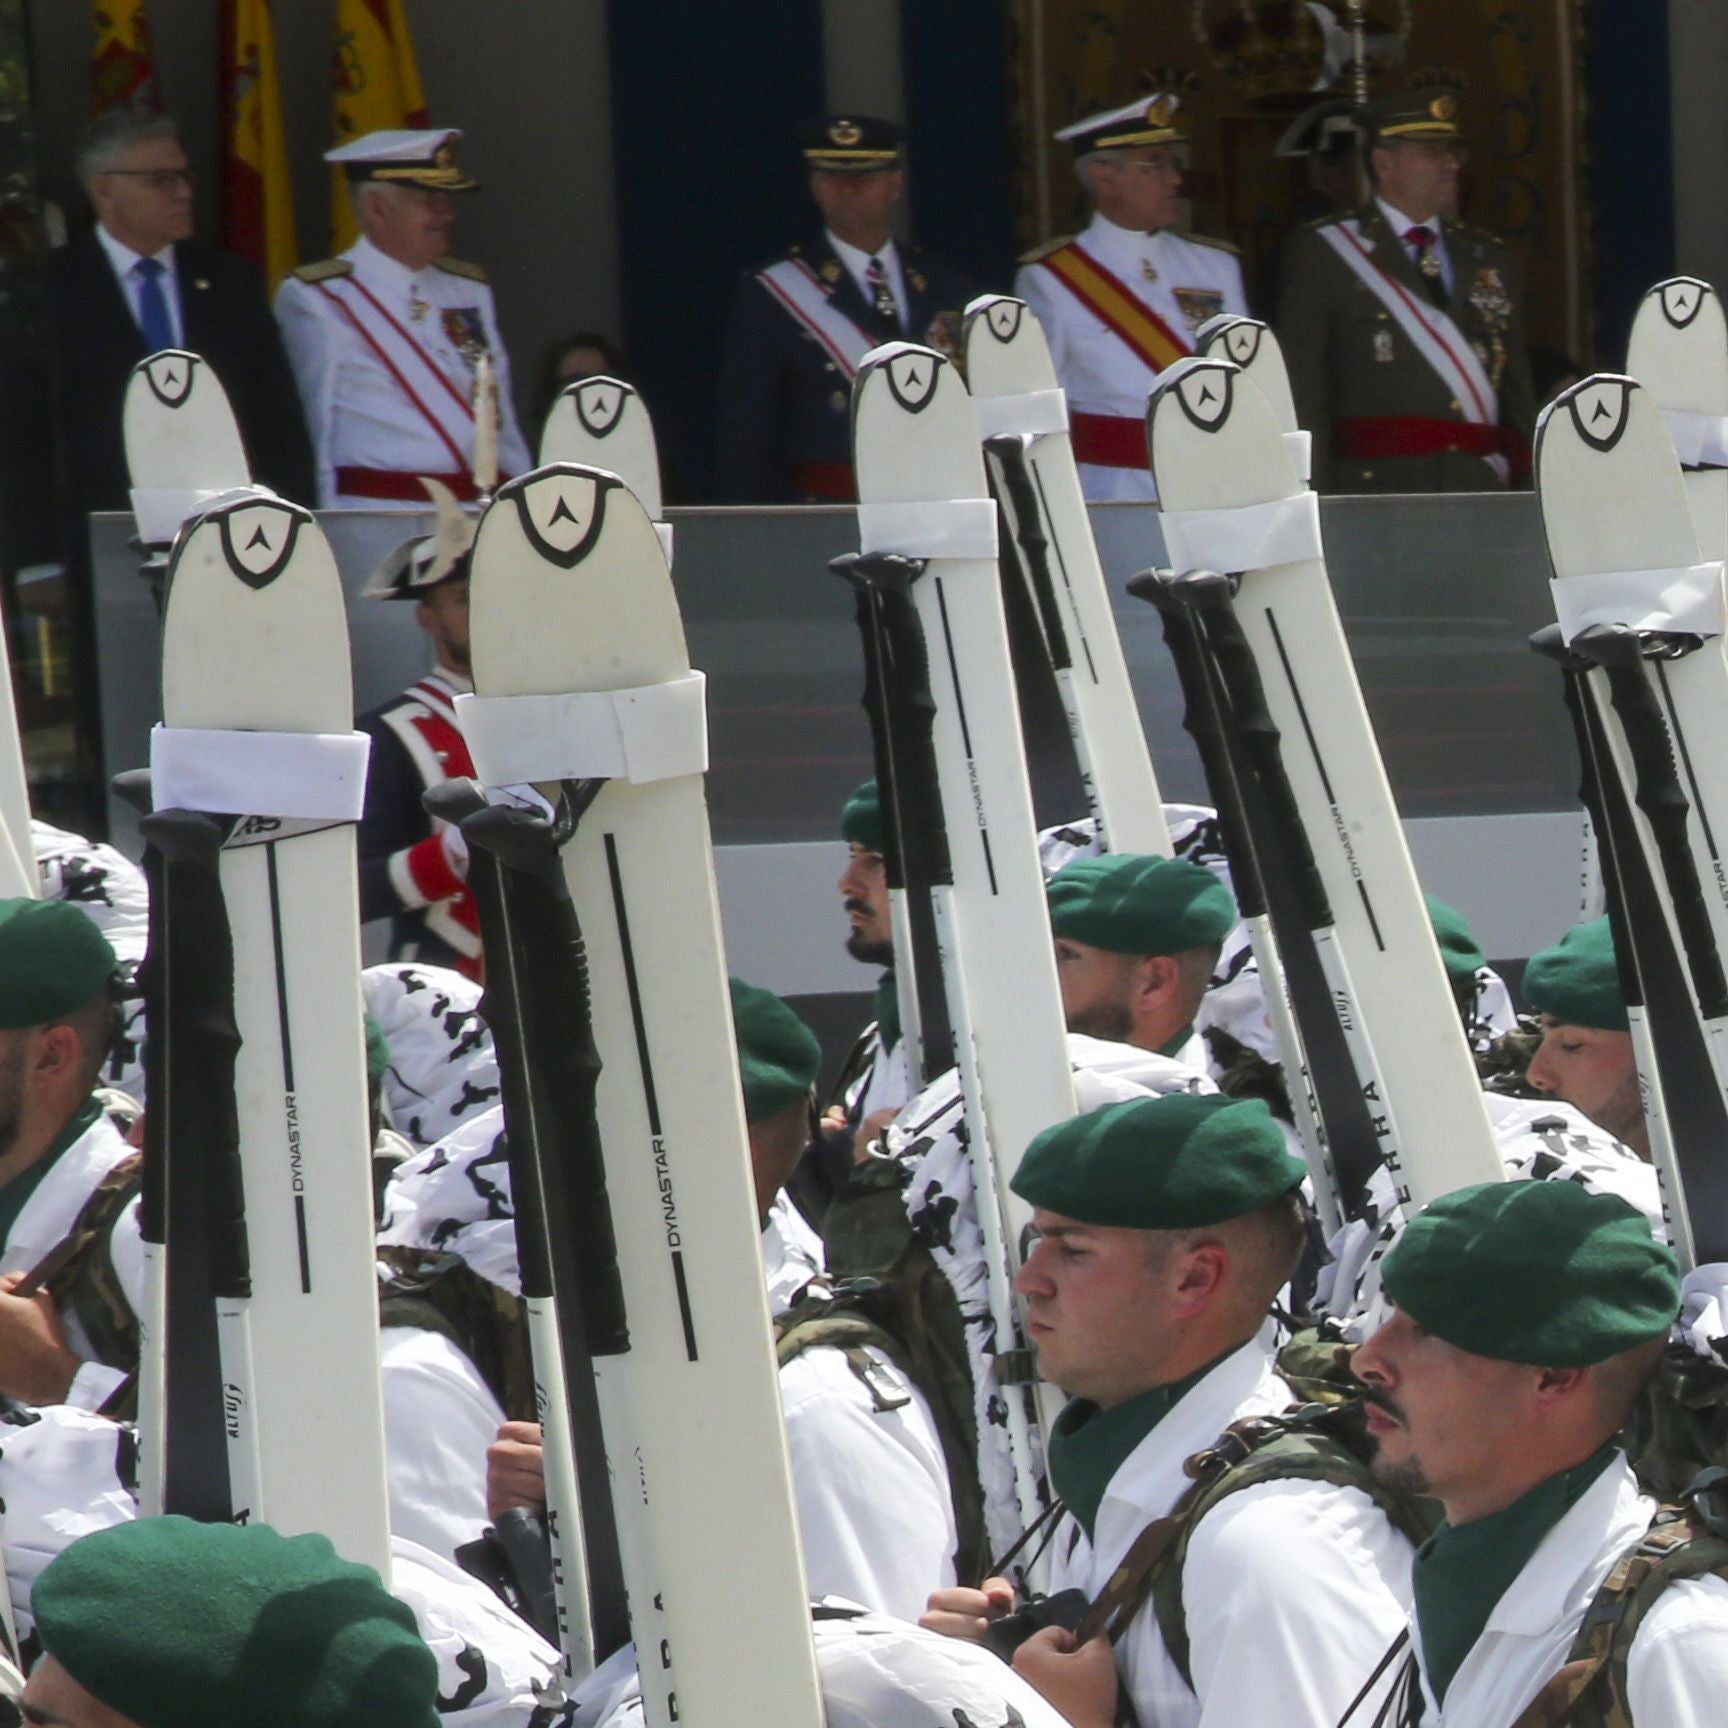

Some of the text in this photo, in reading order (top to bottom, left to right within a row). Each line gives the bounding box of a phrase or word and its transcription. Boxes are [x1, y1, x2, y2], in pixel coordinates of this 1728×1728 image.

[967, 760, 990, 827] DYNASTAR
[1328, 805, 1363, 878] DYNASTAR
[285, 1093, 307, 1193] DYNASTAR
[654, 1138, 682, 1247] DYNASTAR
